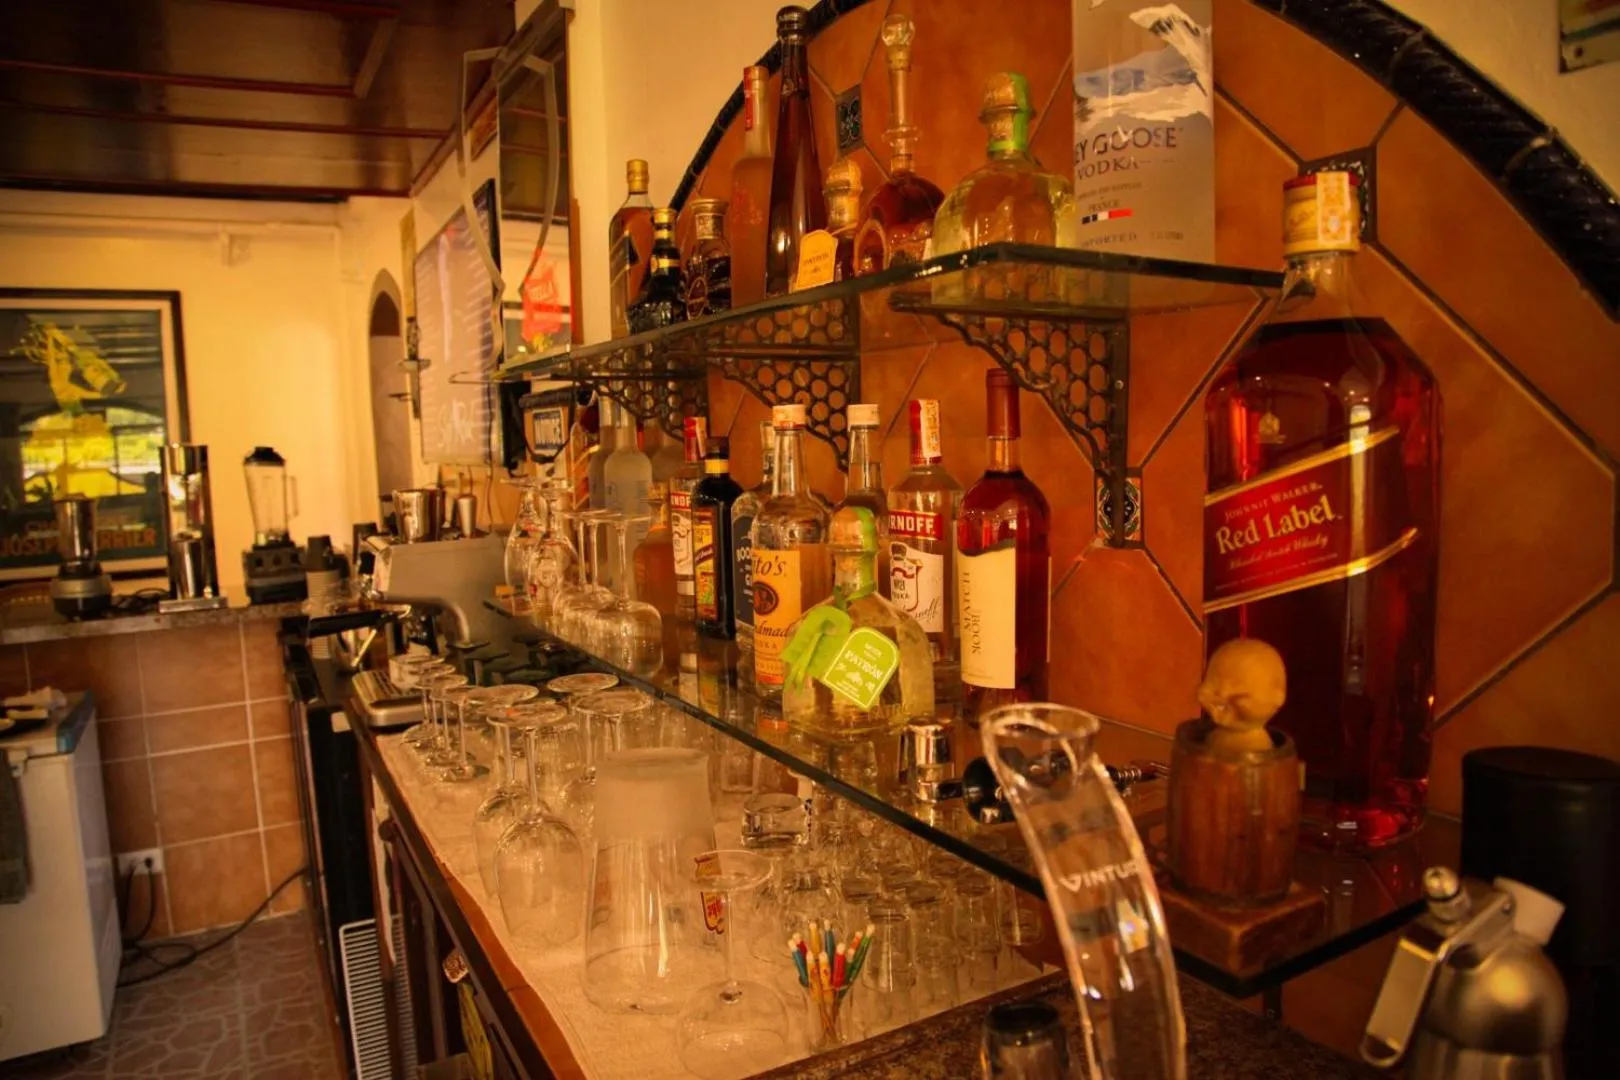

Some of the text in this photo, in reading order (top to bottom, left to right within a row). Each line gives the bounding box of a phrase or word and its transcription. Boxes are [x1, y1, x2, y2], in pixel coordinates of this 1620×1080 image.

[1092, 127, 1177, 156] GOOSE
[1075, 156, 1140, 181] VODKA
[1271, 481, 1320, 504] WALKER
[1215, 494, 1336, 554] Red Label
